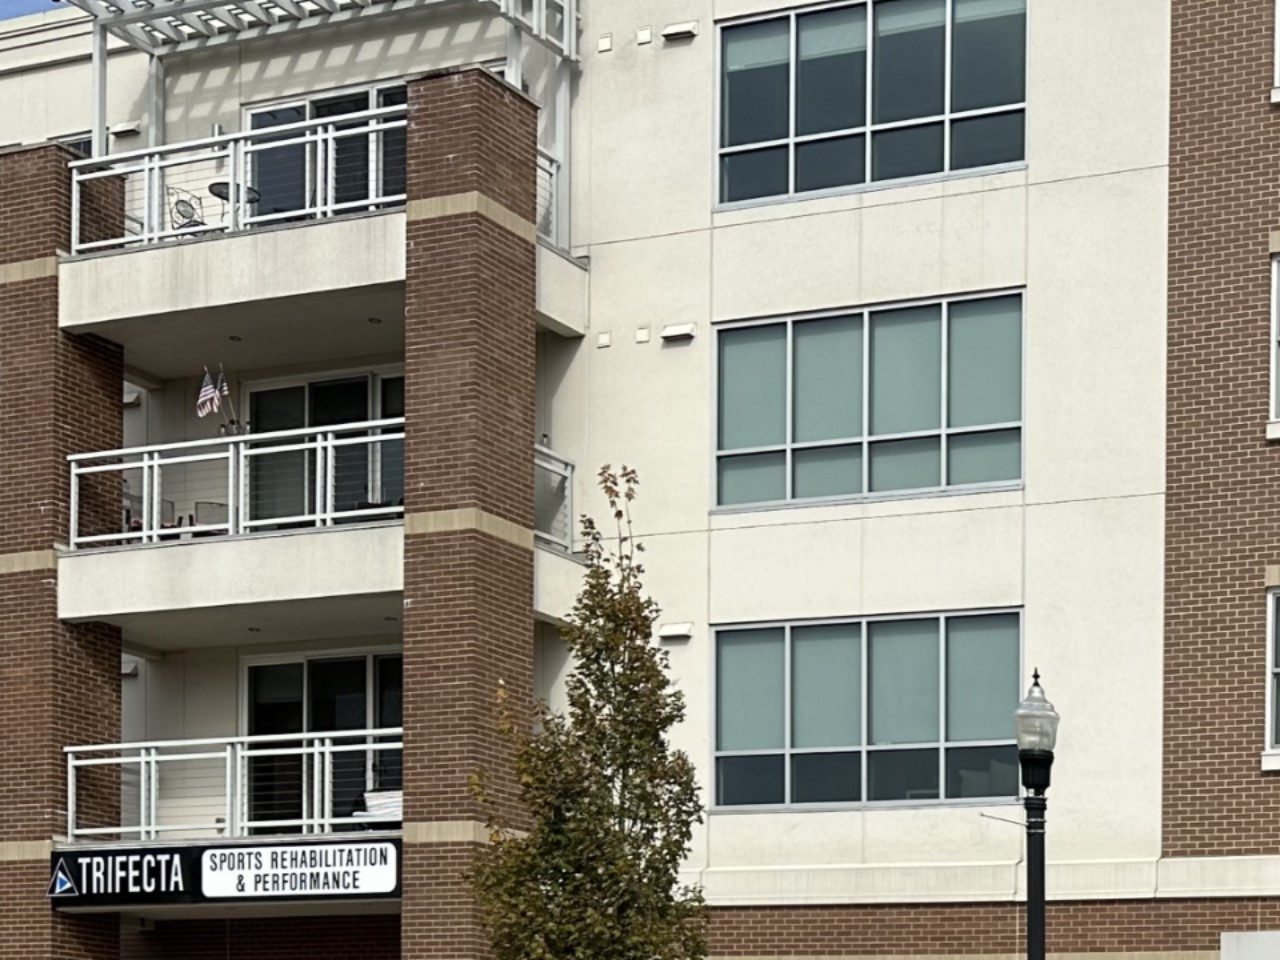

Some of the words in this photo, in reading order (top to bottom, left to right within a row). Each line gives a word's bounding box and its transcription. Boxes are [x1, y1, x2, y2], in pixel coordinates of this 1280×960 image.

[209, 851, 263, 871] SPORTS
[270, 846, 388, 869] REHABILITATION
[77, 853, 184, 894] TRIFECTA
[236, 874, 245, 892] &
[254, 870, 360, 892] PERFORMANCE
